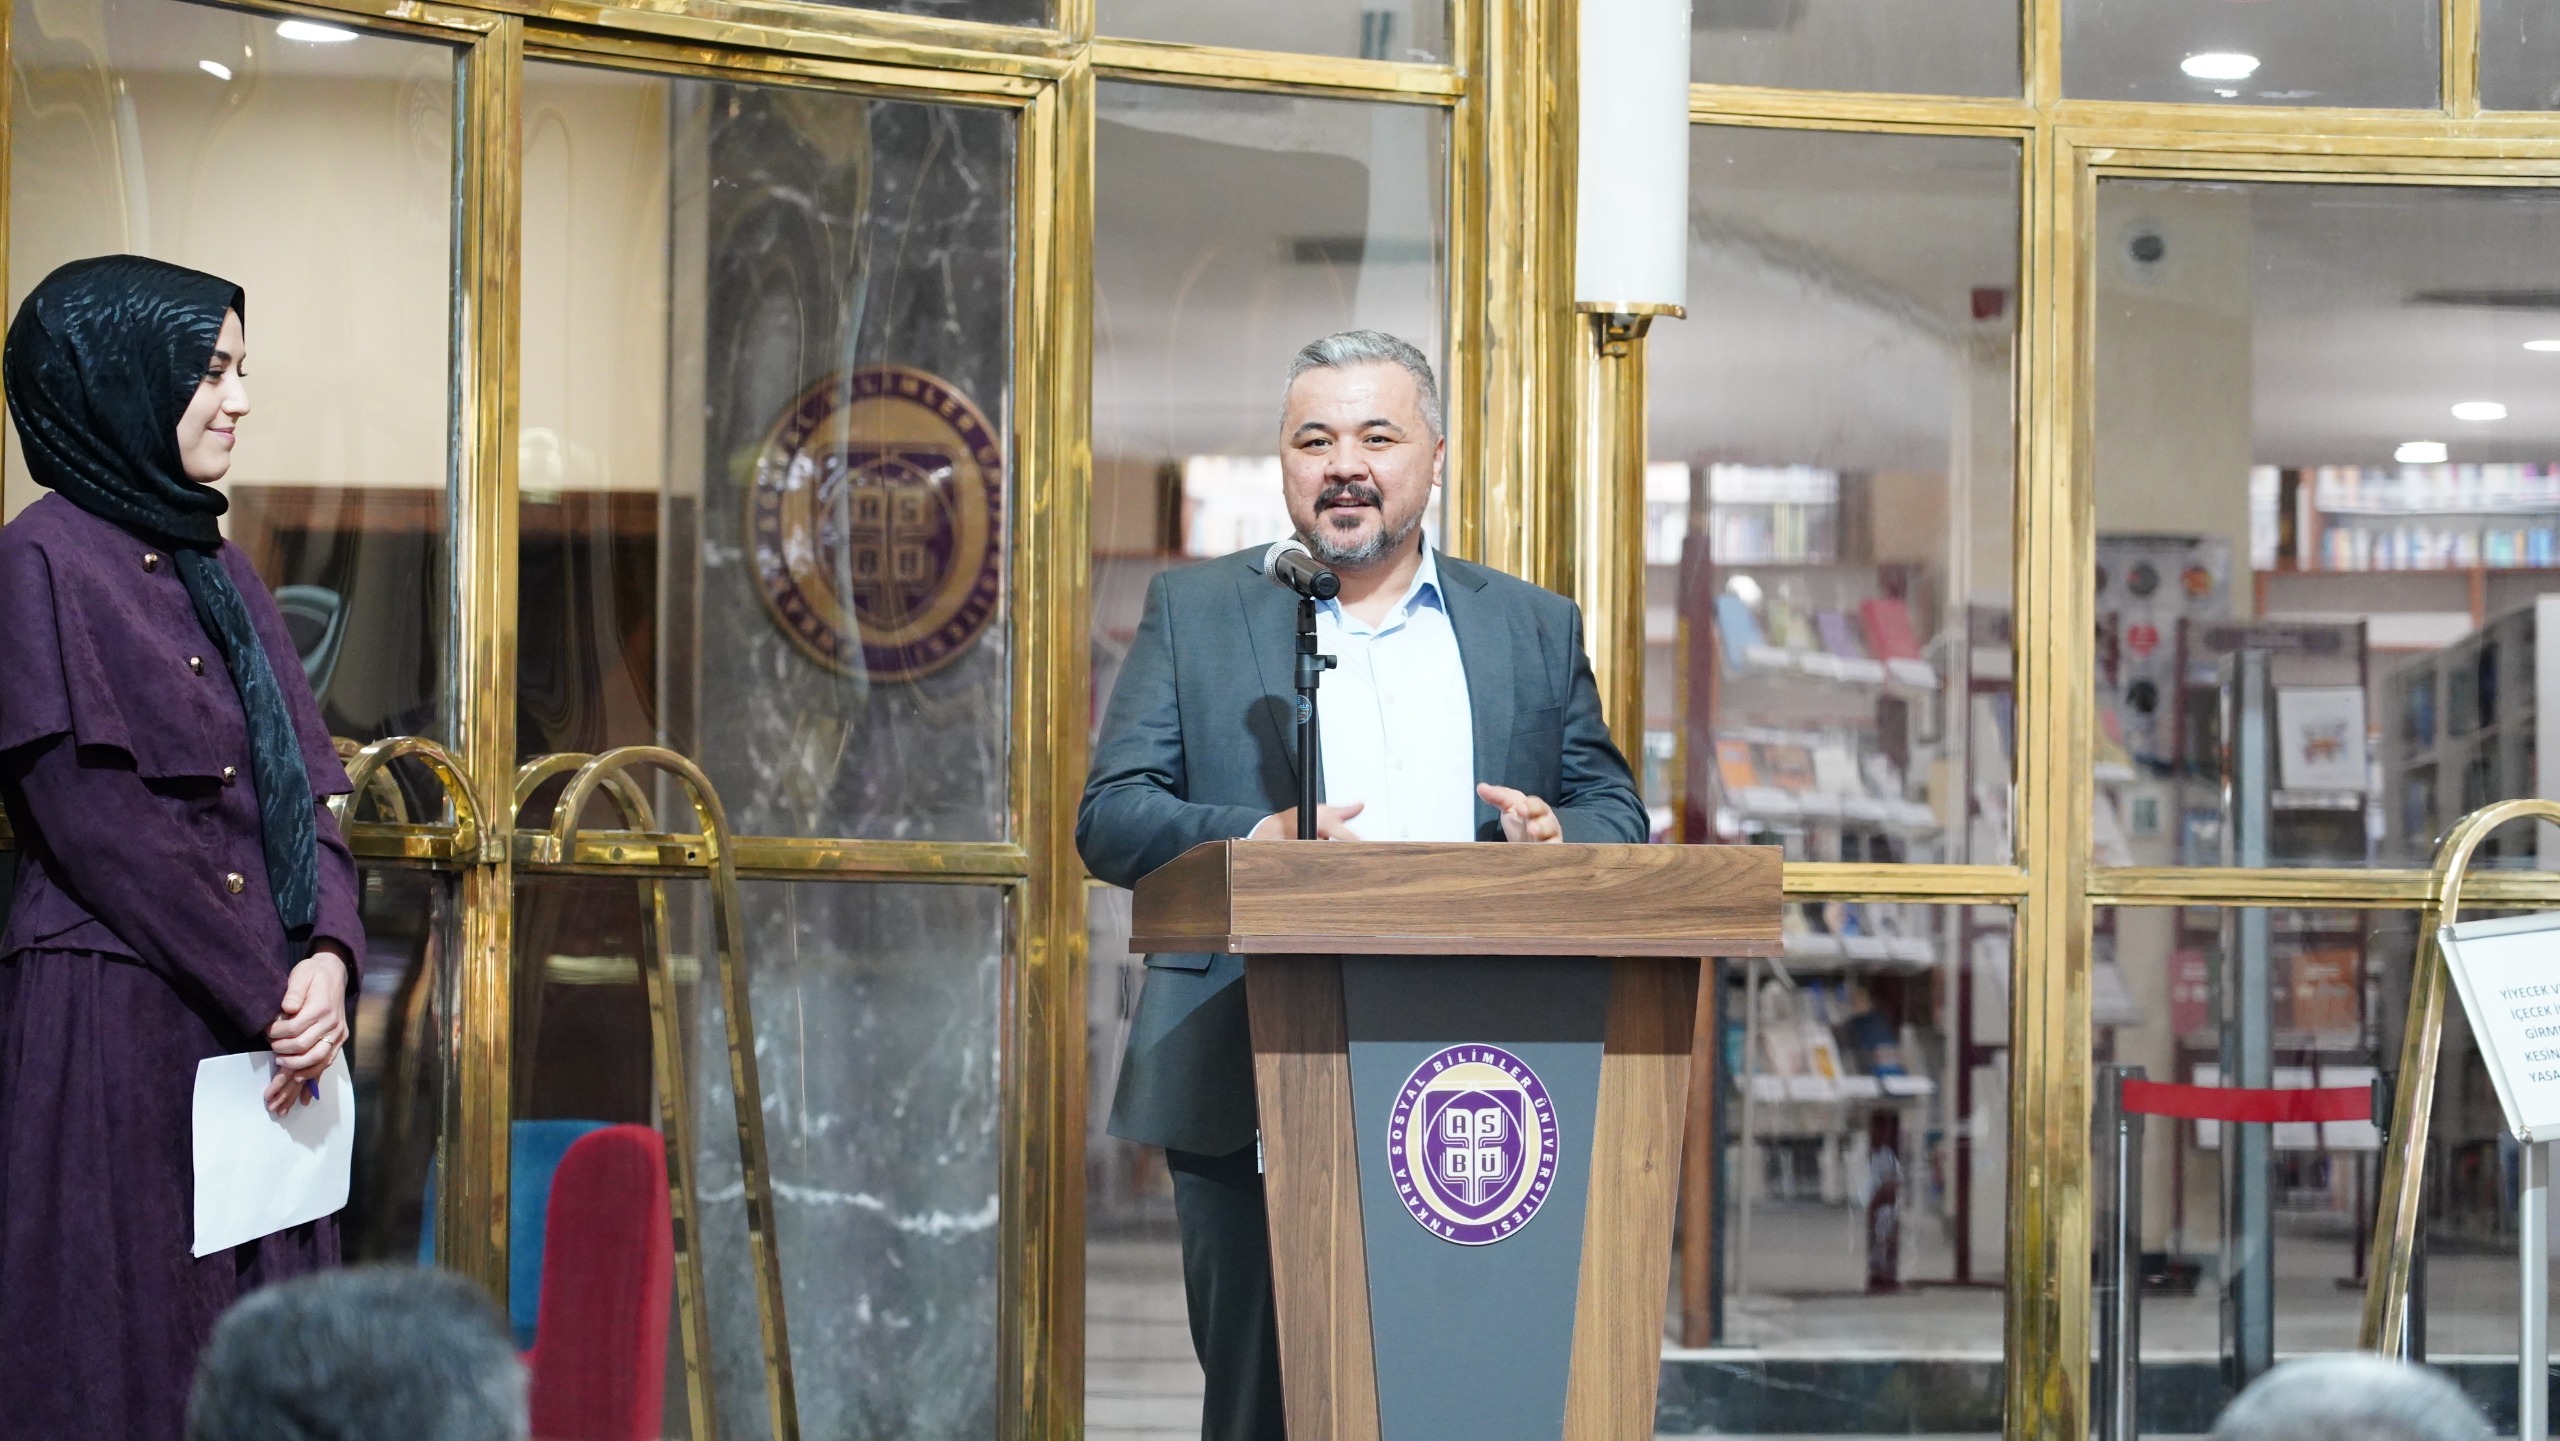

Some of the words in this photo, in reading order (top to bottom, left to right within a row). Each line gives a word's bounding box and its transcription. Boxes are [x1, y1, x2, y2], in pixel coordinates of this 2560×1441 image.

[2499, 985, 2549, 1000] YİYECEK
[2550, 983, 2560, 995] V
[2510, 1005, 2552, 1022] İÇECEK
[2553, 1001, 2560, 1014] İ
[2525, 1025, 2560, 1040] GİRM
[1433, 1049, 1532, 1089] BİLİMLER
[1392, 1078, 1426, 1155] SOSYAL
[1491, 1097, 1555, 1239] ÜNİVERSİTESİ
[1395, 1168, 1456, 1237] ANKARA
